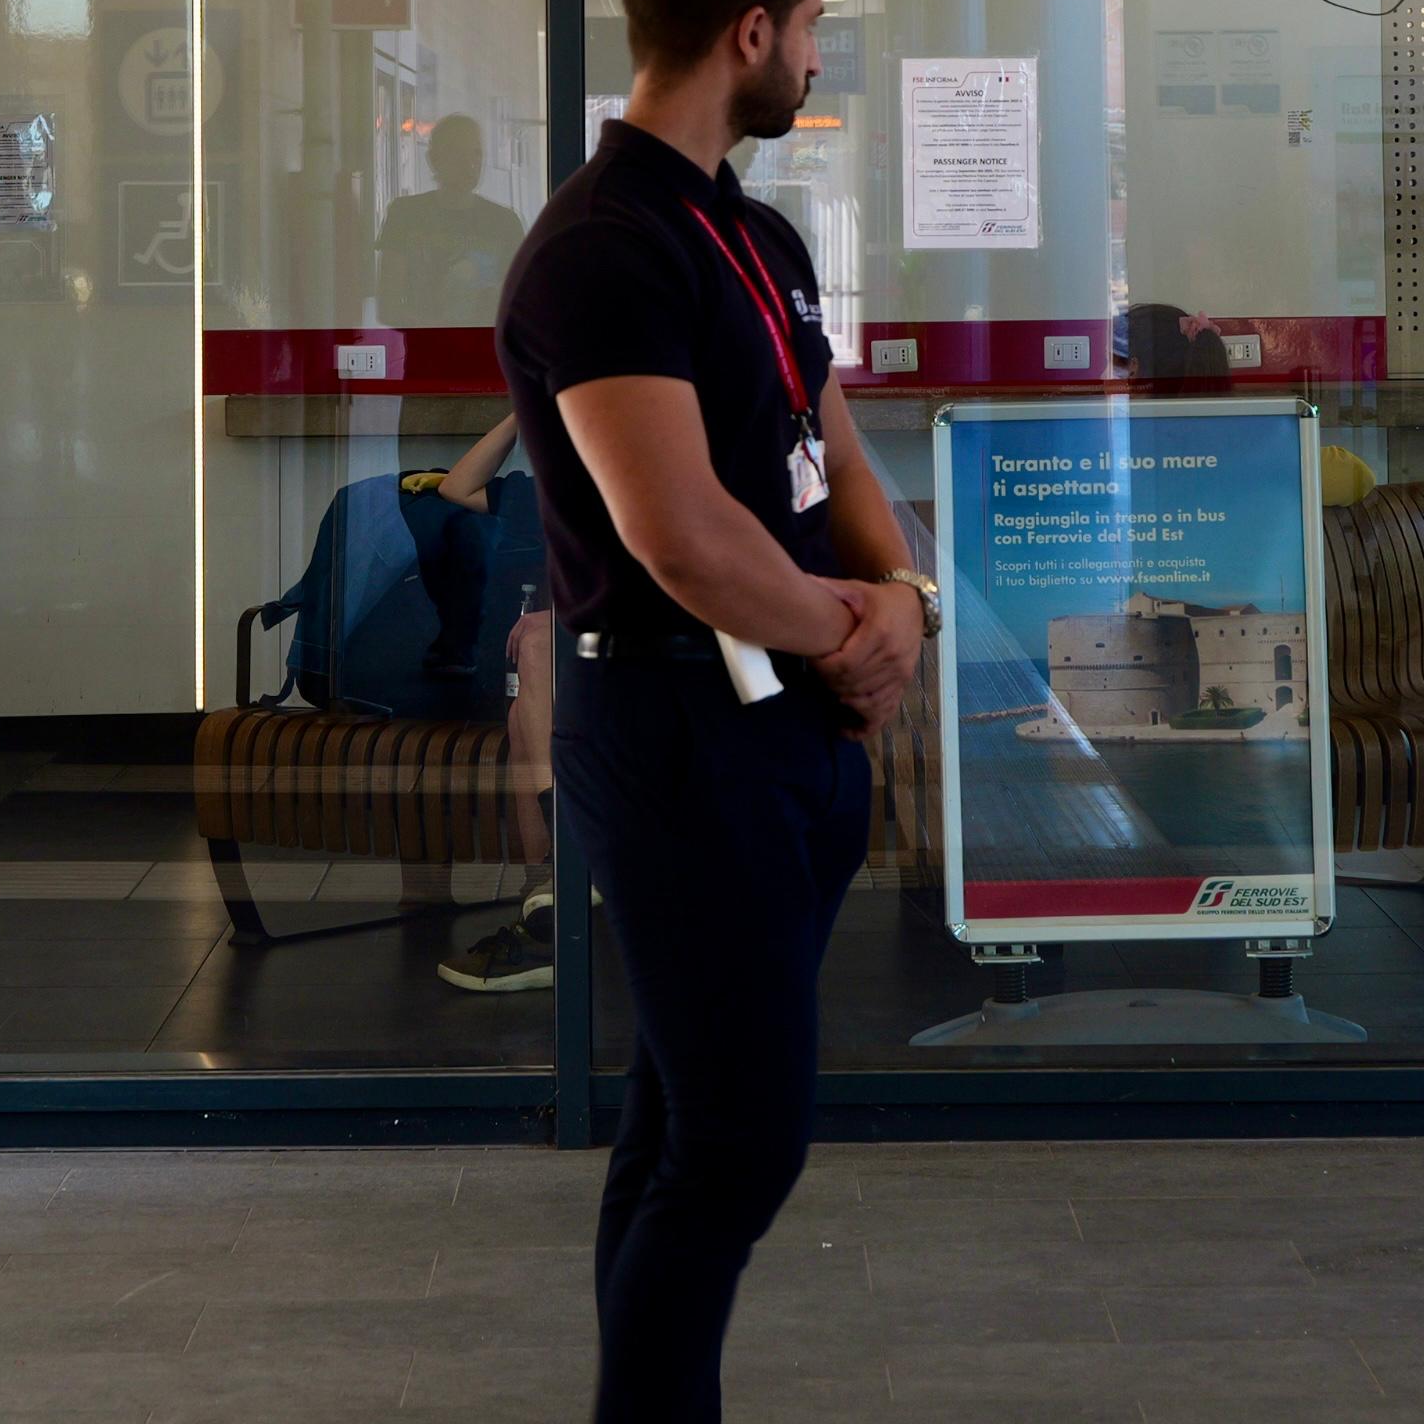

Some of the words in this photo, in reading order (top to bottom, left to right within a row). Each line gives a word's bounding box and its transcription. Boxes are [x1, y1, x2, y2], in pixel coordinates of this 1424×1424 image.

[955, 89, 984, 97] AVVISO
[933, 158, 977, 166] PASSENGER
[992, 454, 1073, 473] Taranto
[1079, 458, 1092, 471] e
[1099, 452, 1110, 470] il
[1118, 456, 1155, 470] suo
[1163, 455, 1218, 469] mare
[993, 480, 1006, 497] ti
[1013, 479, 1119, 501] aspettano
[994, 511, 1089, 530] Raggiungila
[1096, 511, 1110, 524] in
[1114, 511, 1157, 524] treno
[1162, 513, 1172, 523] o
[1177, 510, 1192, 522] in
[1197, 508, 1226, 522] bus
[994, 533, 1021, 545] con
[1027, 530, 1092, 544] Ferrovie
[1098, 528, 1121, 543] del
[1127, 528, 1156, 542] Sud
[1162, 528, 1184, 541] Est
[995, 559, 1031, 574] Scopri
[1035, 559, 1058, 570] tutti
[1068, 557, 1143, 573] collegamenti
[1147, 559, 1154, 568] e
[1158, 557, 1206, 570] acquista
[996, 574, 1003, 586] il
[1006, 575, 1025, 586] tuo
[1028, 574, 1076, 588] biglietto
[1079, 576, 1093, 585] su
[1097, 571, 1210, 585] www.fseonline.it
[1234, 887, 1299, 897] FERROVIE
[1230, 898, 1252, 907] DEL
[1255, 898, 1280, 907] SUD
[1283, 897, 1308, 906] EST
